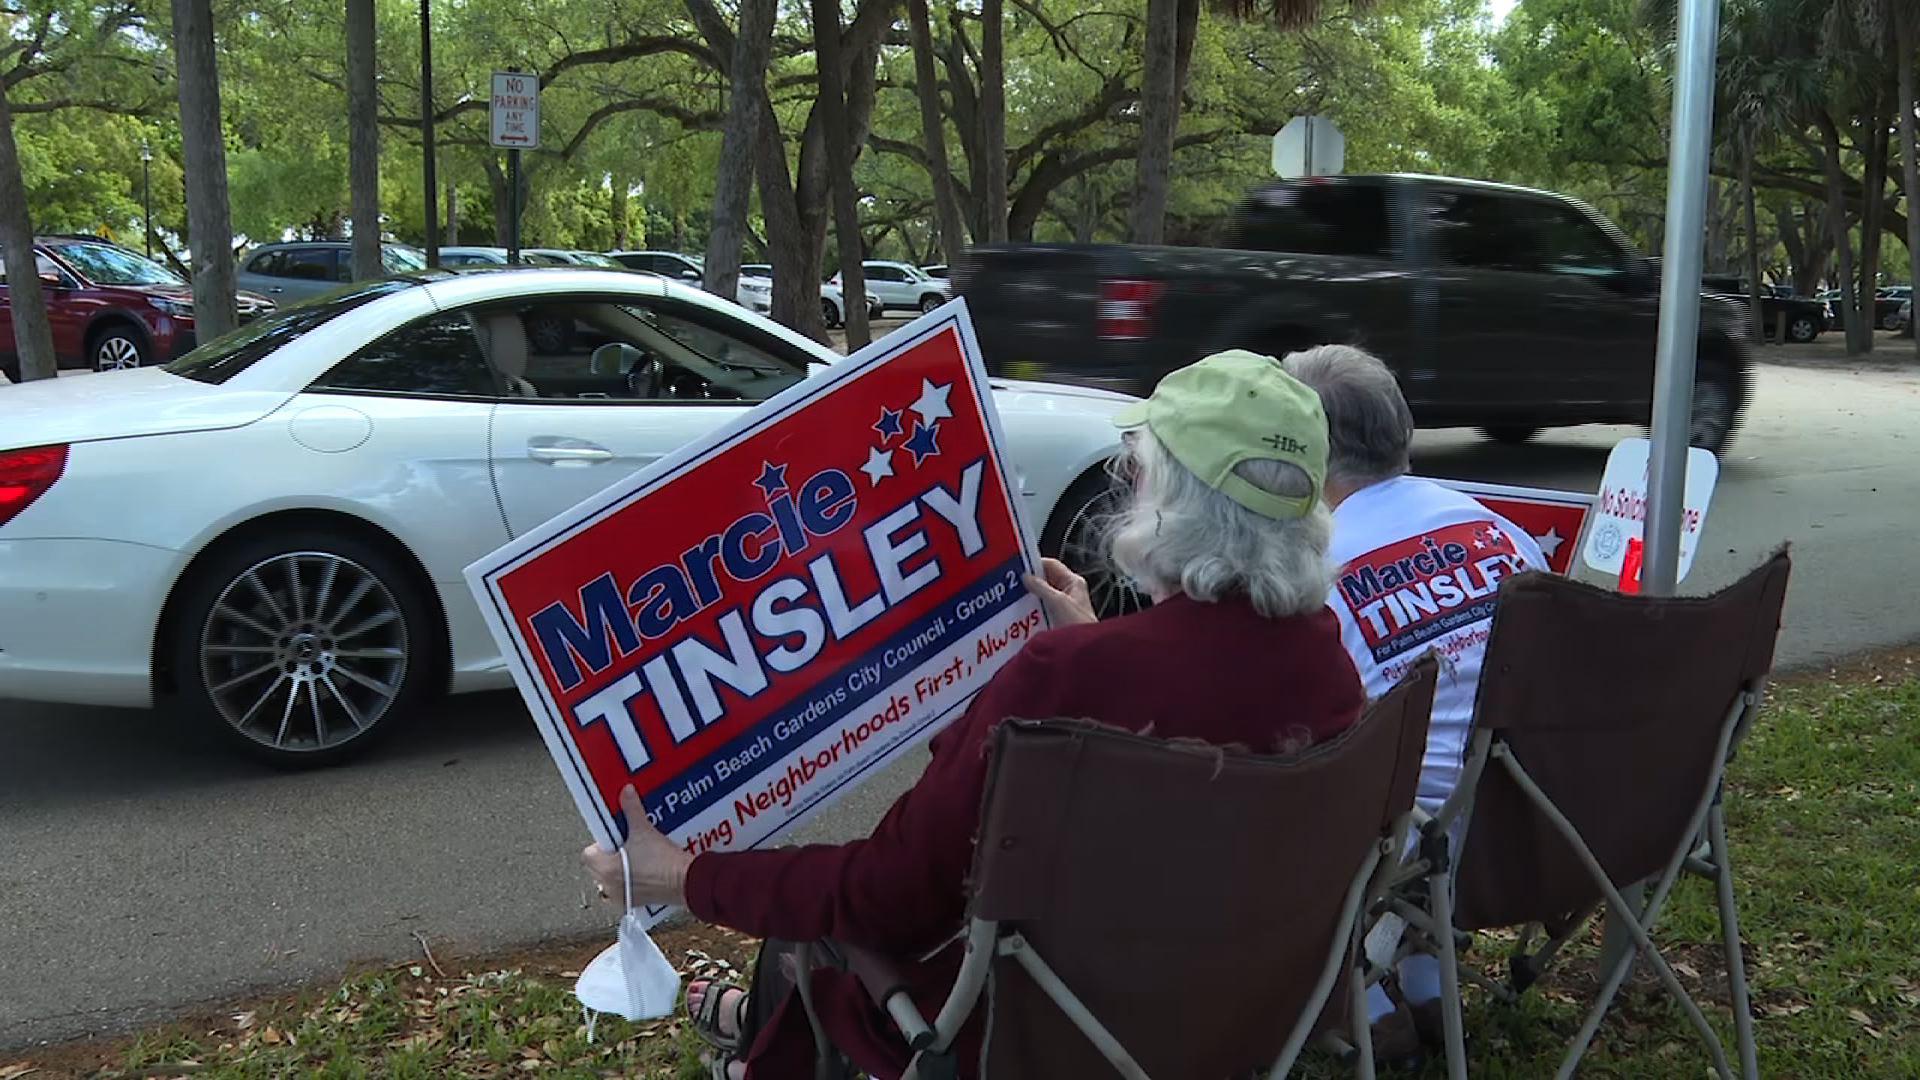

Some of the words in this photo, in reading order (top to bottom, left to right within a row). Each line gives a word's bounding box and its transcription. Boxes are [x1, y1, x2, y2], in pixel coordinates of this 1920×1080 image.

[494, 95, 535, 111] PARKING
[507, 79, 524, 94] NO
[504, 121, 525, 133] TIME
[505, 112, 524, 121] ANY
[527, 467, 857, 693] Marcie
[1341, 542, 1467, 606] Marcie
[571, 455, 986, 774] TINSLEY
[1376, 645, 1391, 658] For
[1391, 634, 1414, 651] Palm
[1413, 623, 1443, 640] Beach
[1440, 611, 1472, 631] Gardens
[1472, 604, 1488, 621] City
[645, 804, 664, 826] or
[665, 777, 714, 814] Palm
[713, 736, 772, 781] Beach
[773, 687, 846, 740] Gardens
[848, 663, 882, 692] City
[884, 617, 945, 669] Council
[956, 581, 1006, 621] Group
[1006, 570, 1019, 588] 2
[684, 819, 733, 856] ting
[734, 696, 910, 827] Neighborhoods
[914, 656, 971, 705] First,
[976, 609, 1040, 664] Always
